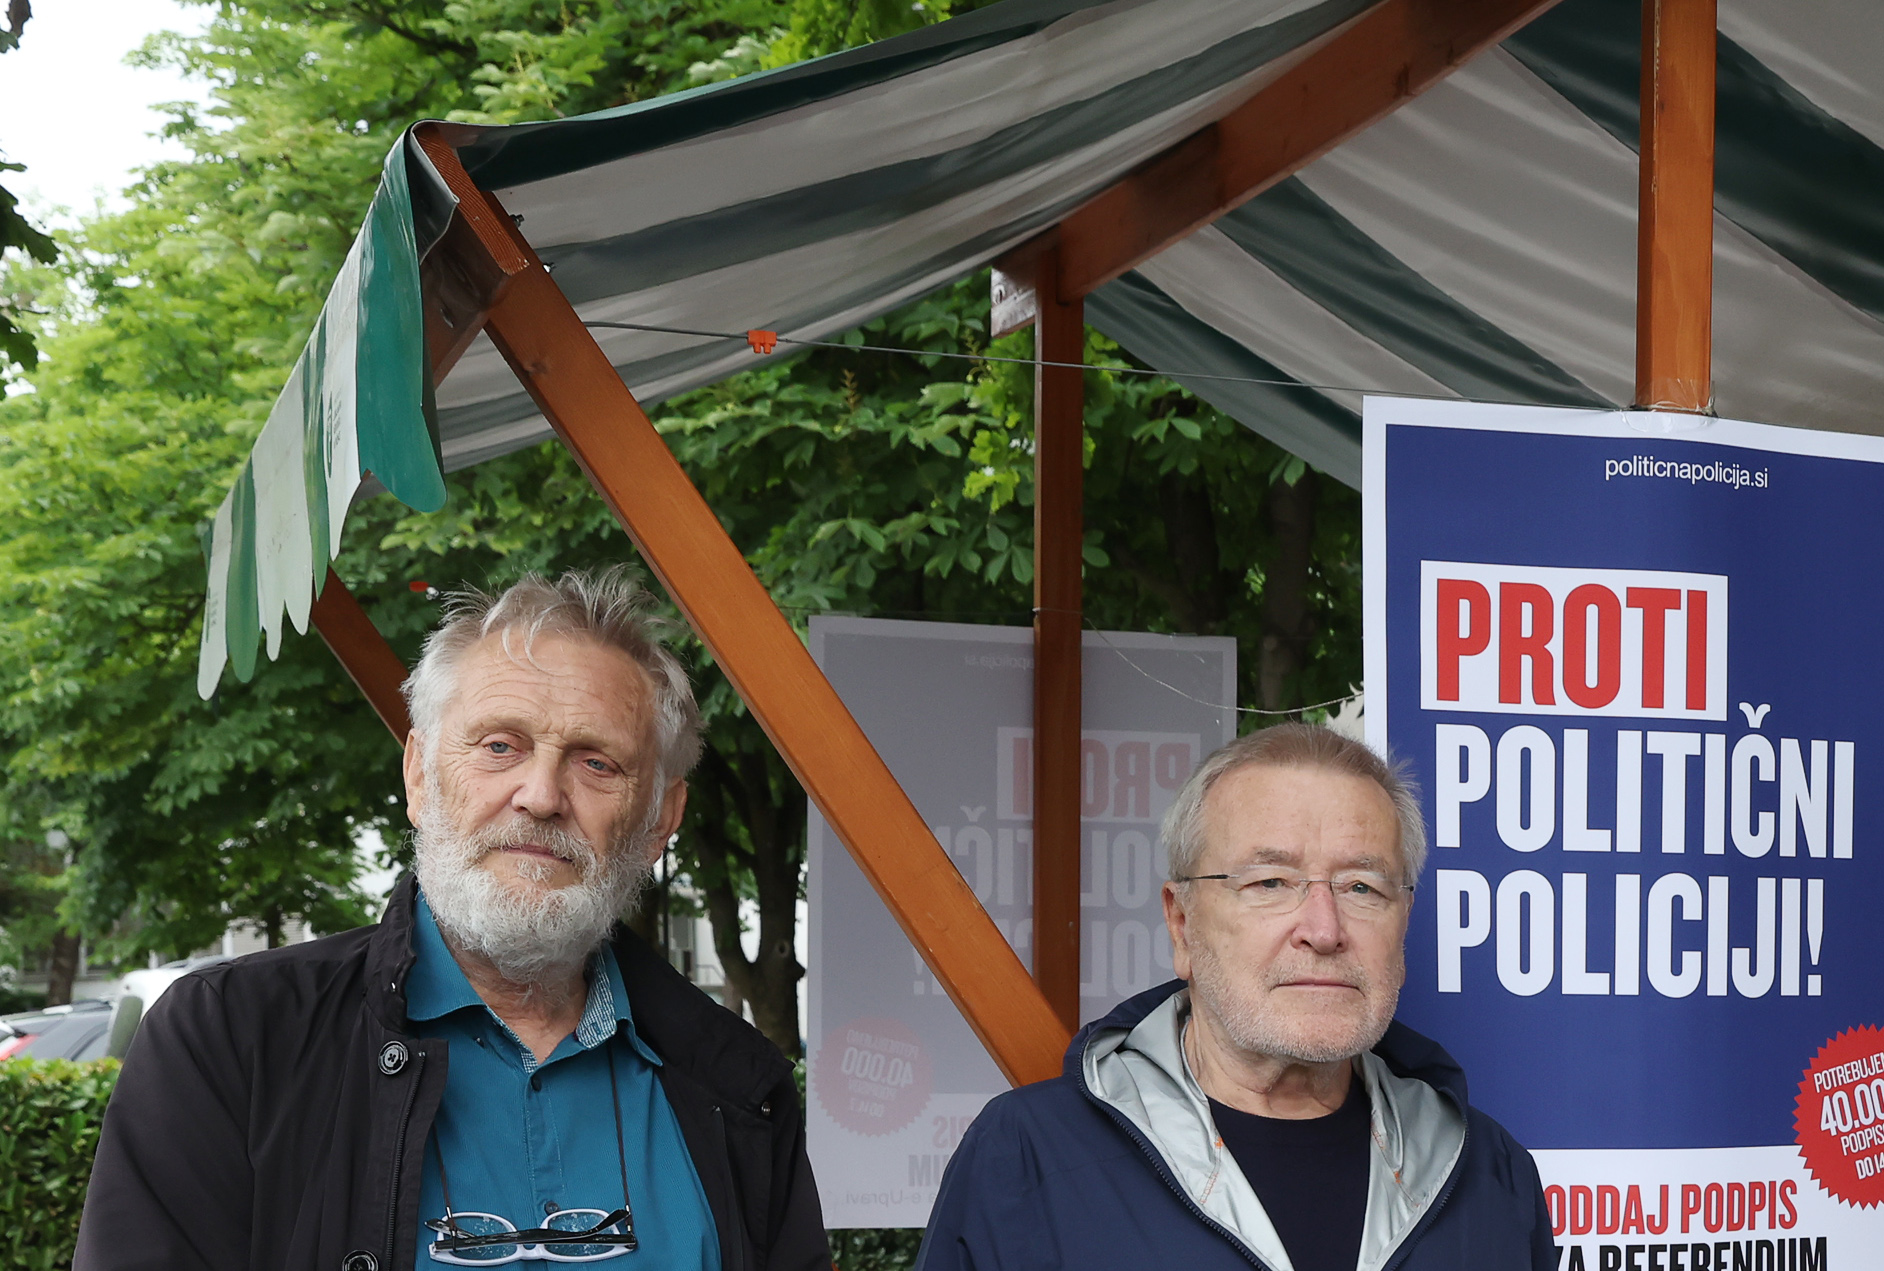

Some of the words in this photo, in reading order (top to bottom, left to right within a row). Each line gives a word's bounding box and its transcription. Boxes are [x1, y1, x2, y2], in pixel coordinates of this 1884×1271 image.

[1604, 454, 1769, 489] politicnapolicija.si
[1436, 578, 1708, 711] PROTI
[1435, 702, 1855, 859] POLITIČNI
[1435, 868, 1825, 999] POLICIJI!
[1680, 1179, 1798, 1234] PODPIS
[1855, 1156, 1875, 1180] DO
